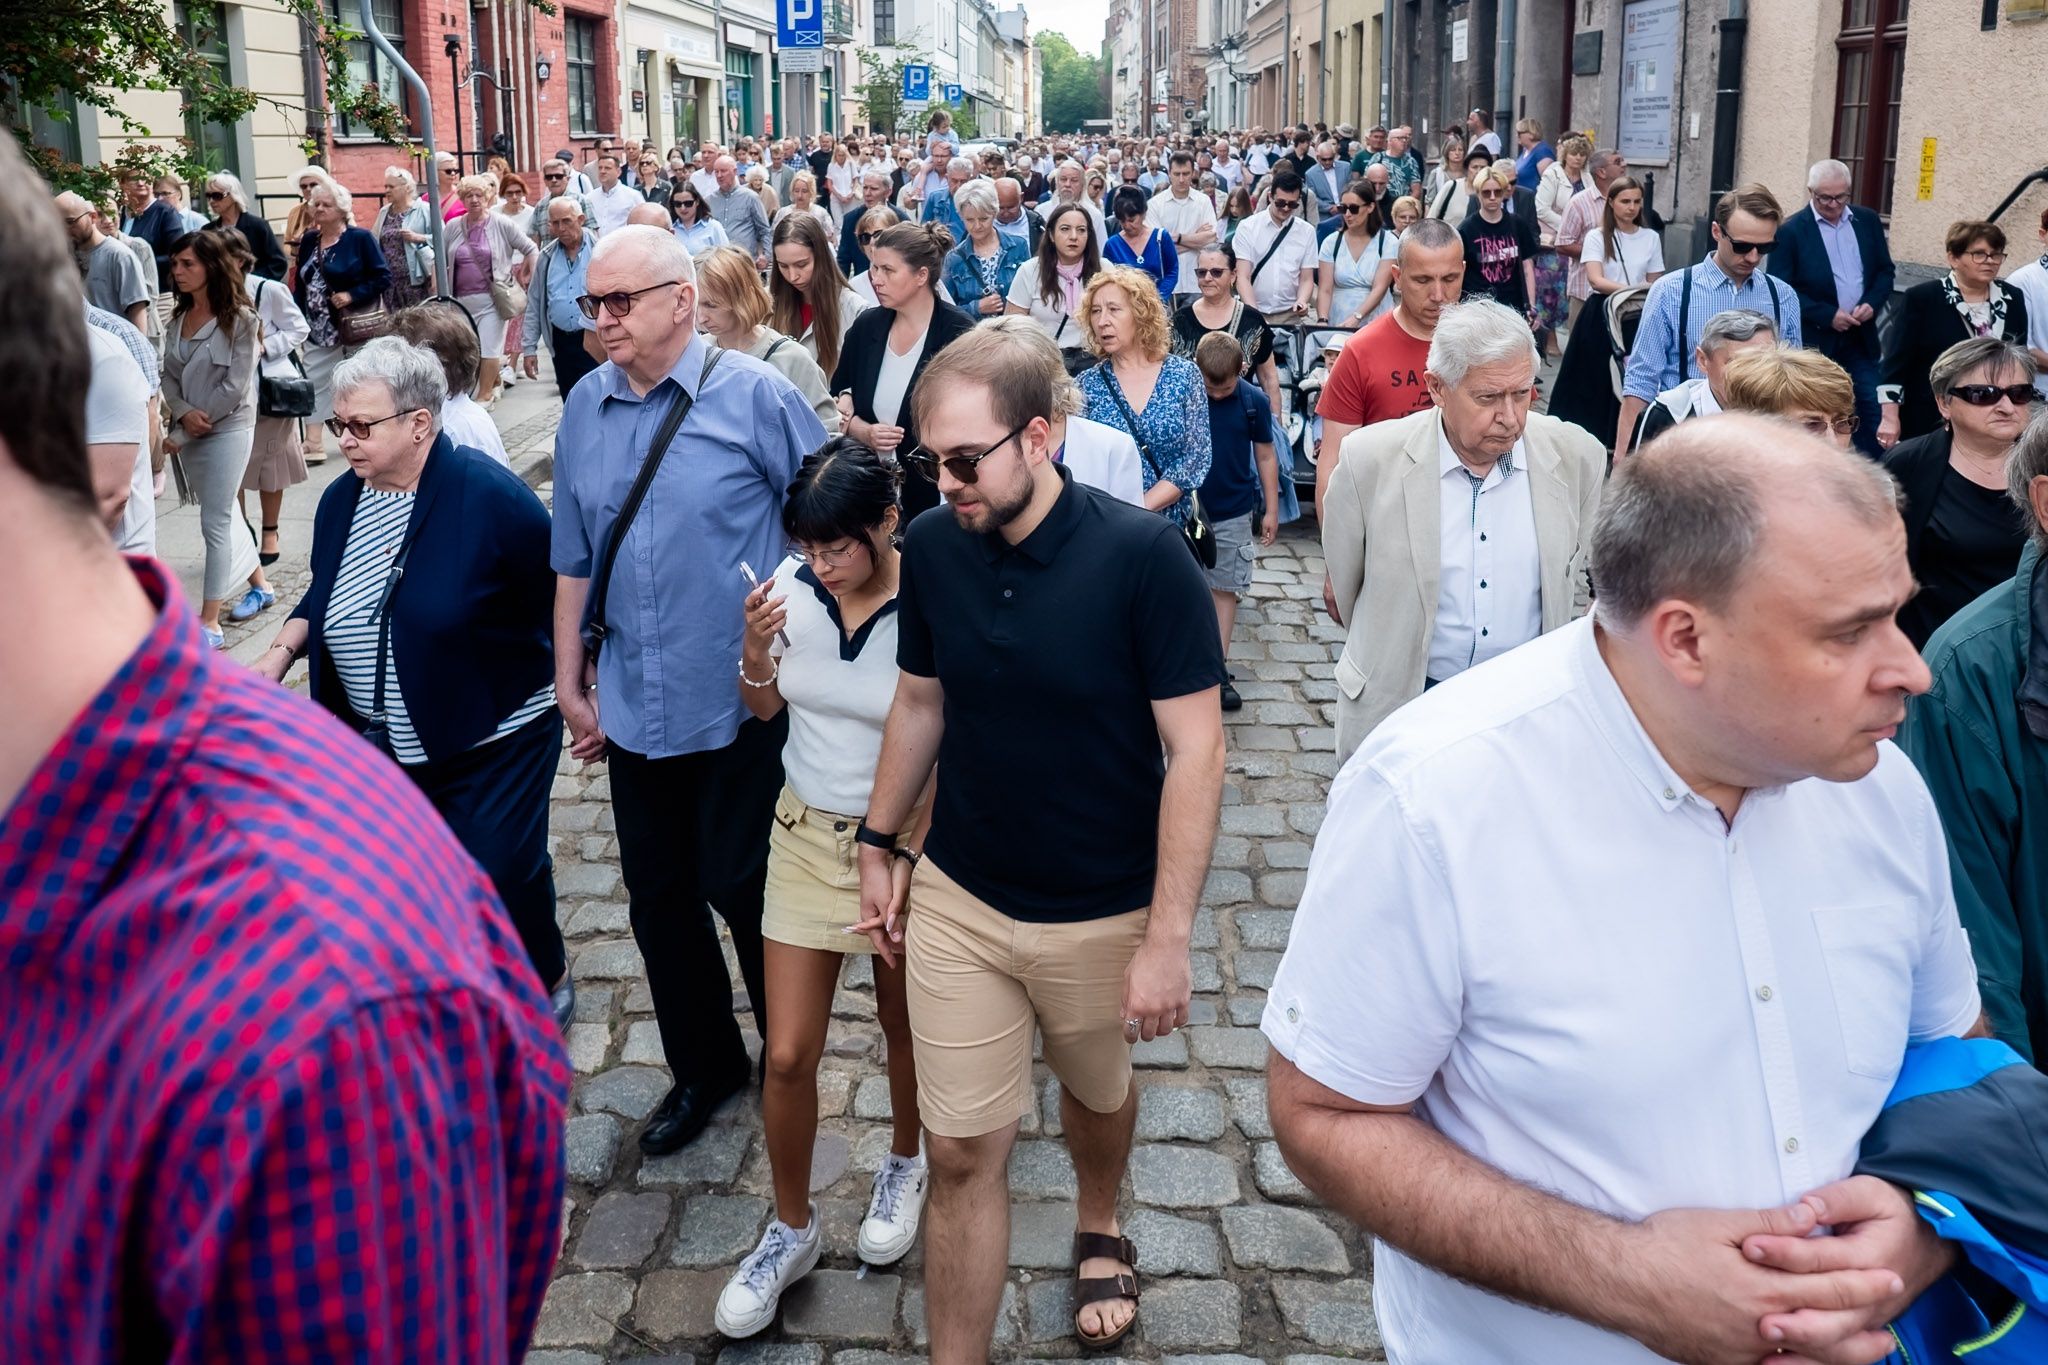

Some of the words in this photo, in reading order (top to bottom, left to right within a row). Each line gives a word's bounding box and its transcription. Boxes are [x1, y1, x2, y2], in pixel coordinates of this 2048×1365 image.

[787, 0, 814, 30] P
[909, 68, 925, 90] P
[947, 86, 959, 101] P
[1391, 369, 1427, 387] SA
